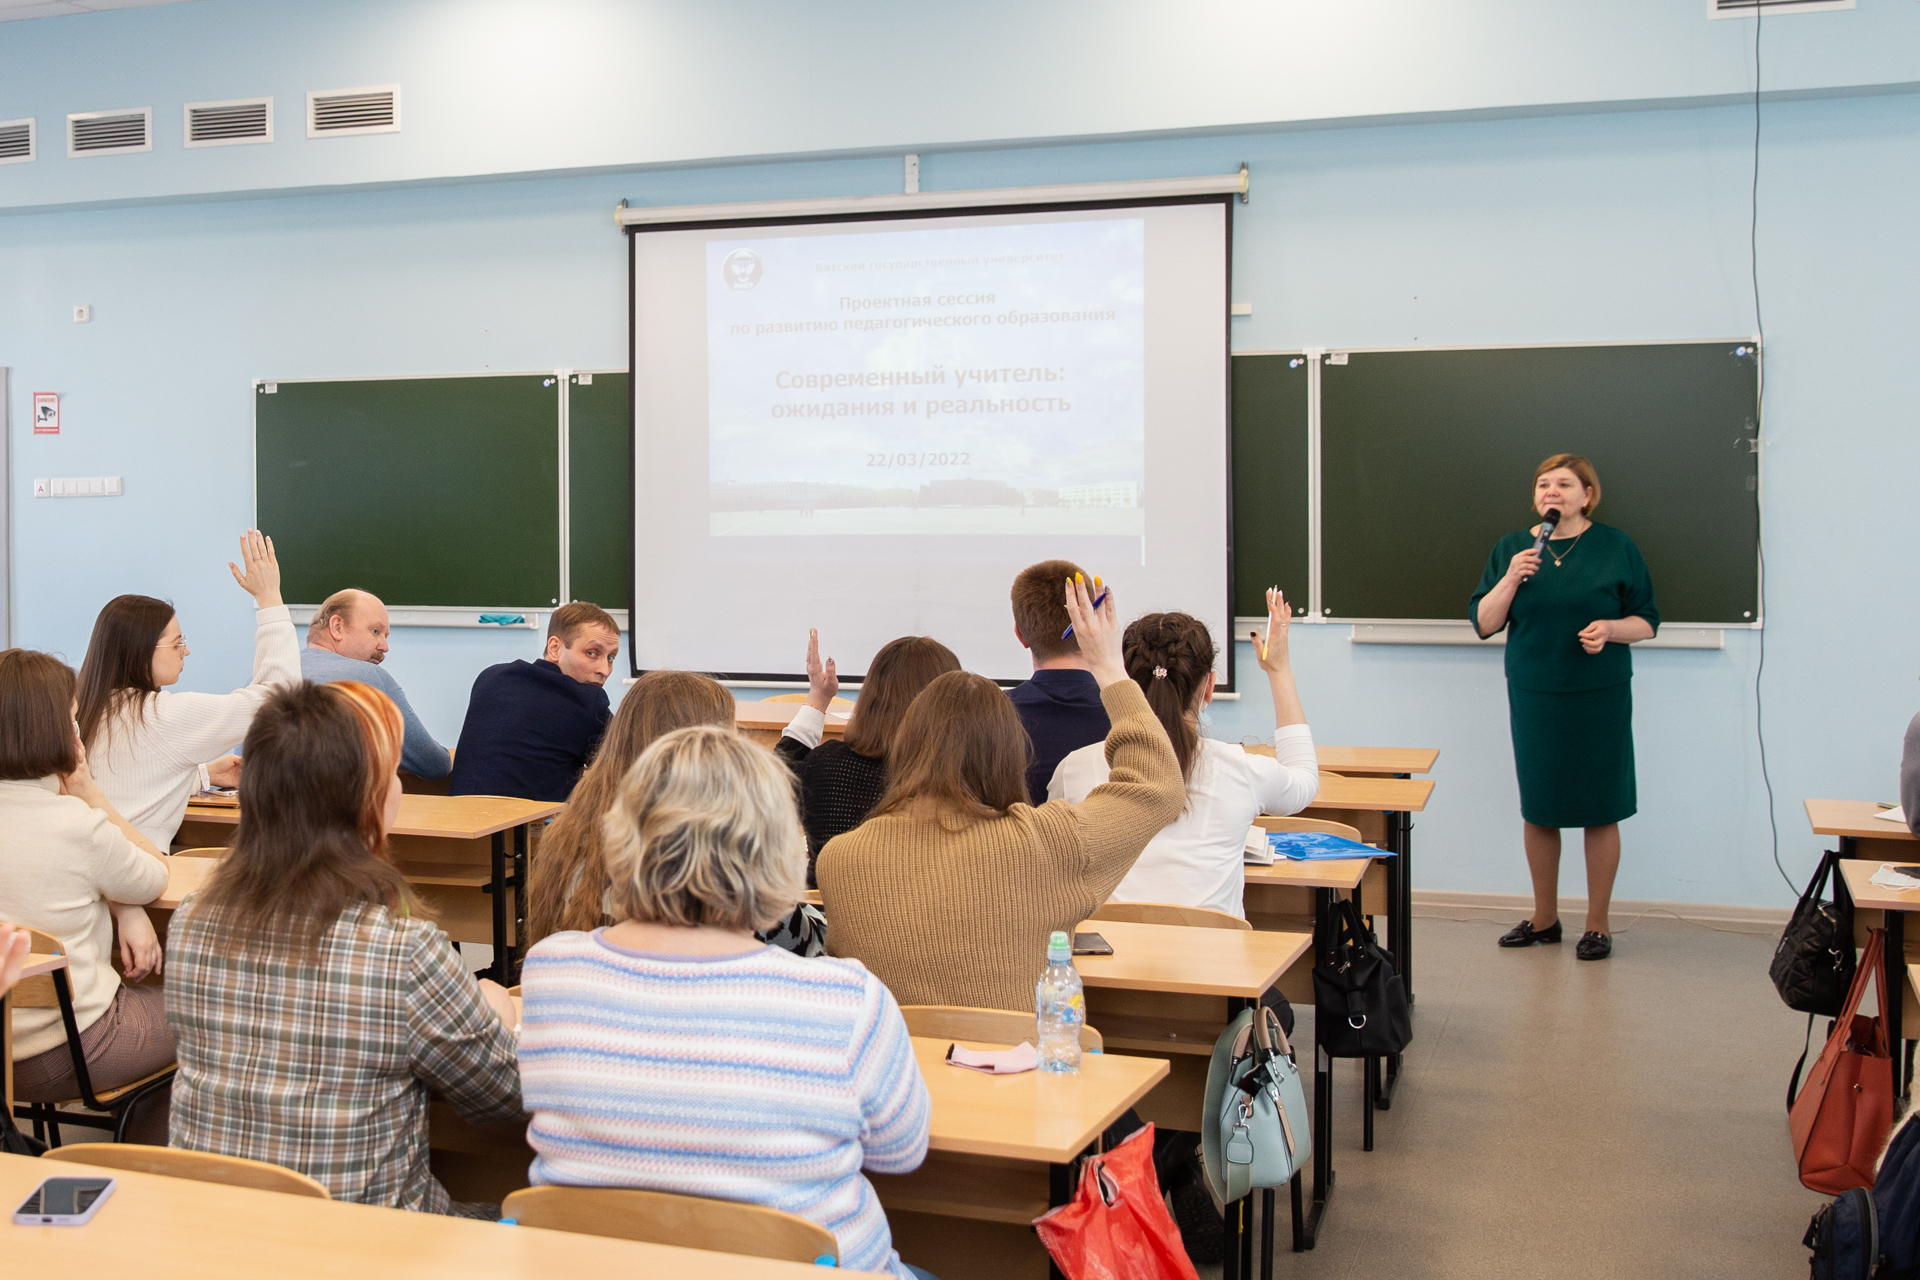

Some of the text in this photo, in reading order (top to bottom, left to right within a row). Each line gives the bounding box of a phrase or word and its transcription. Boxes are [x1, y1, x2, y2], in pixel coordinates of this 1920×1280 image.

[815, 252, 1065, 272] Вятский государственный университет
[839, 292, 996, 312] Проектная сессия
[730, 309, 1116, 336] по развитию педагогического образования
[775, 364, 1066, 392] Современный учитель:
[771, 395, 1072, 420] ожидания и реальность
[866, 452, 971, 469] 22/03/2022
